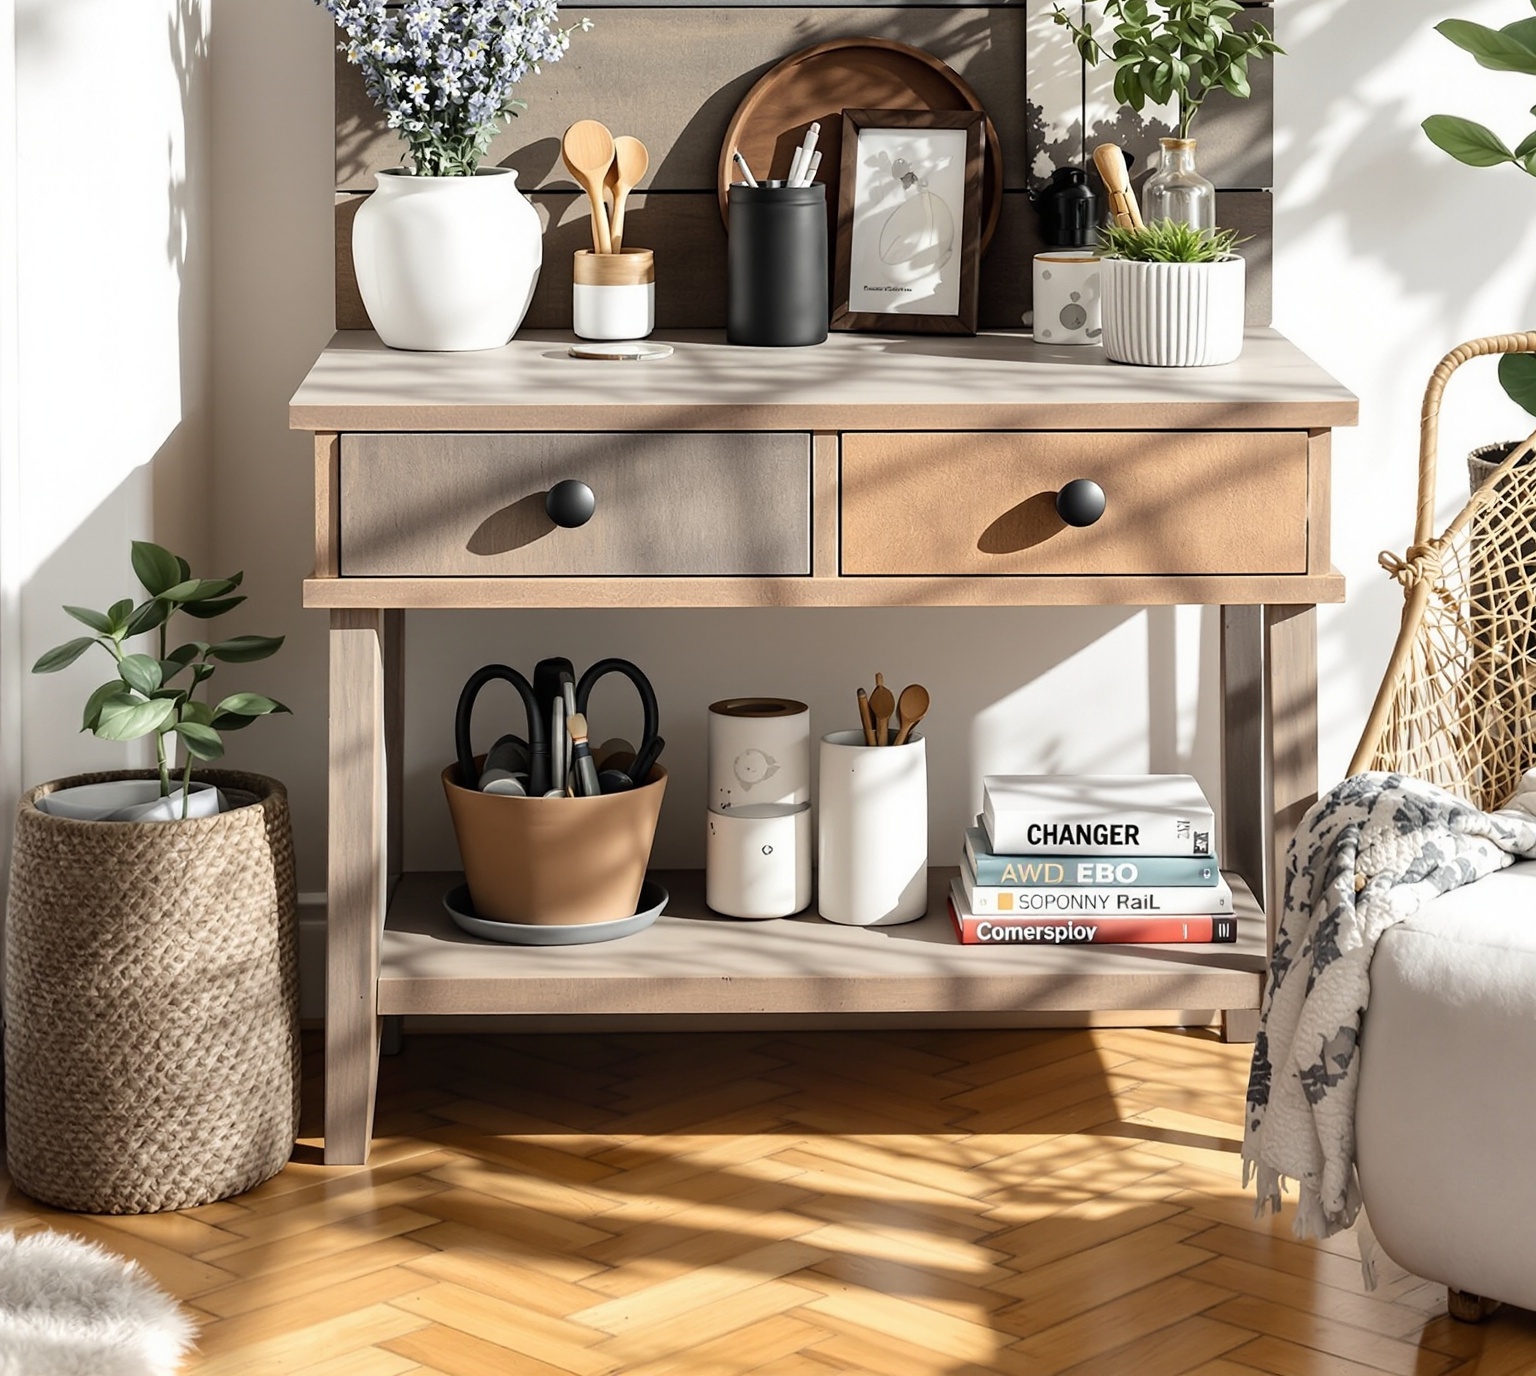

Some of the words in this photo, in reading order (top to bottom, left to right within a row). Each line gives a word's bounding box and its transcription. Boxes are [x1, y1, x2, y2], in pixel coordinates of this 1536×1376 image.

[1027, 823, 1140, 846] CHANGER
[1001, 863, 1064, 884] AWD
[1076, 862, 1139, 884] EBO
[1019, 894, 1110, 910] SOPONNY
